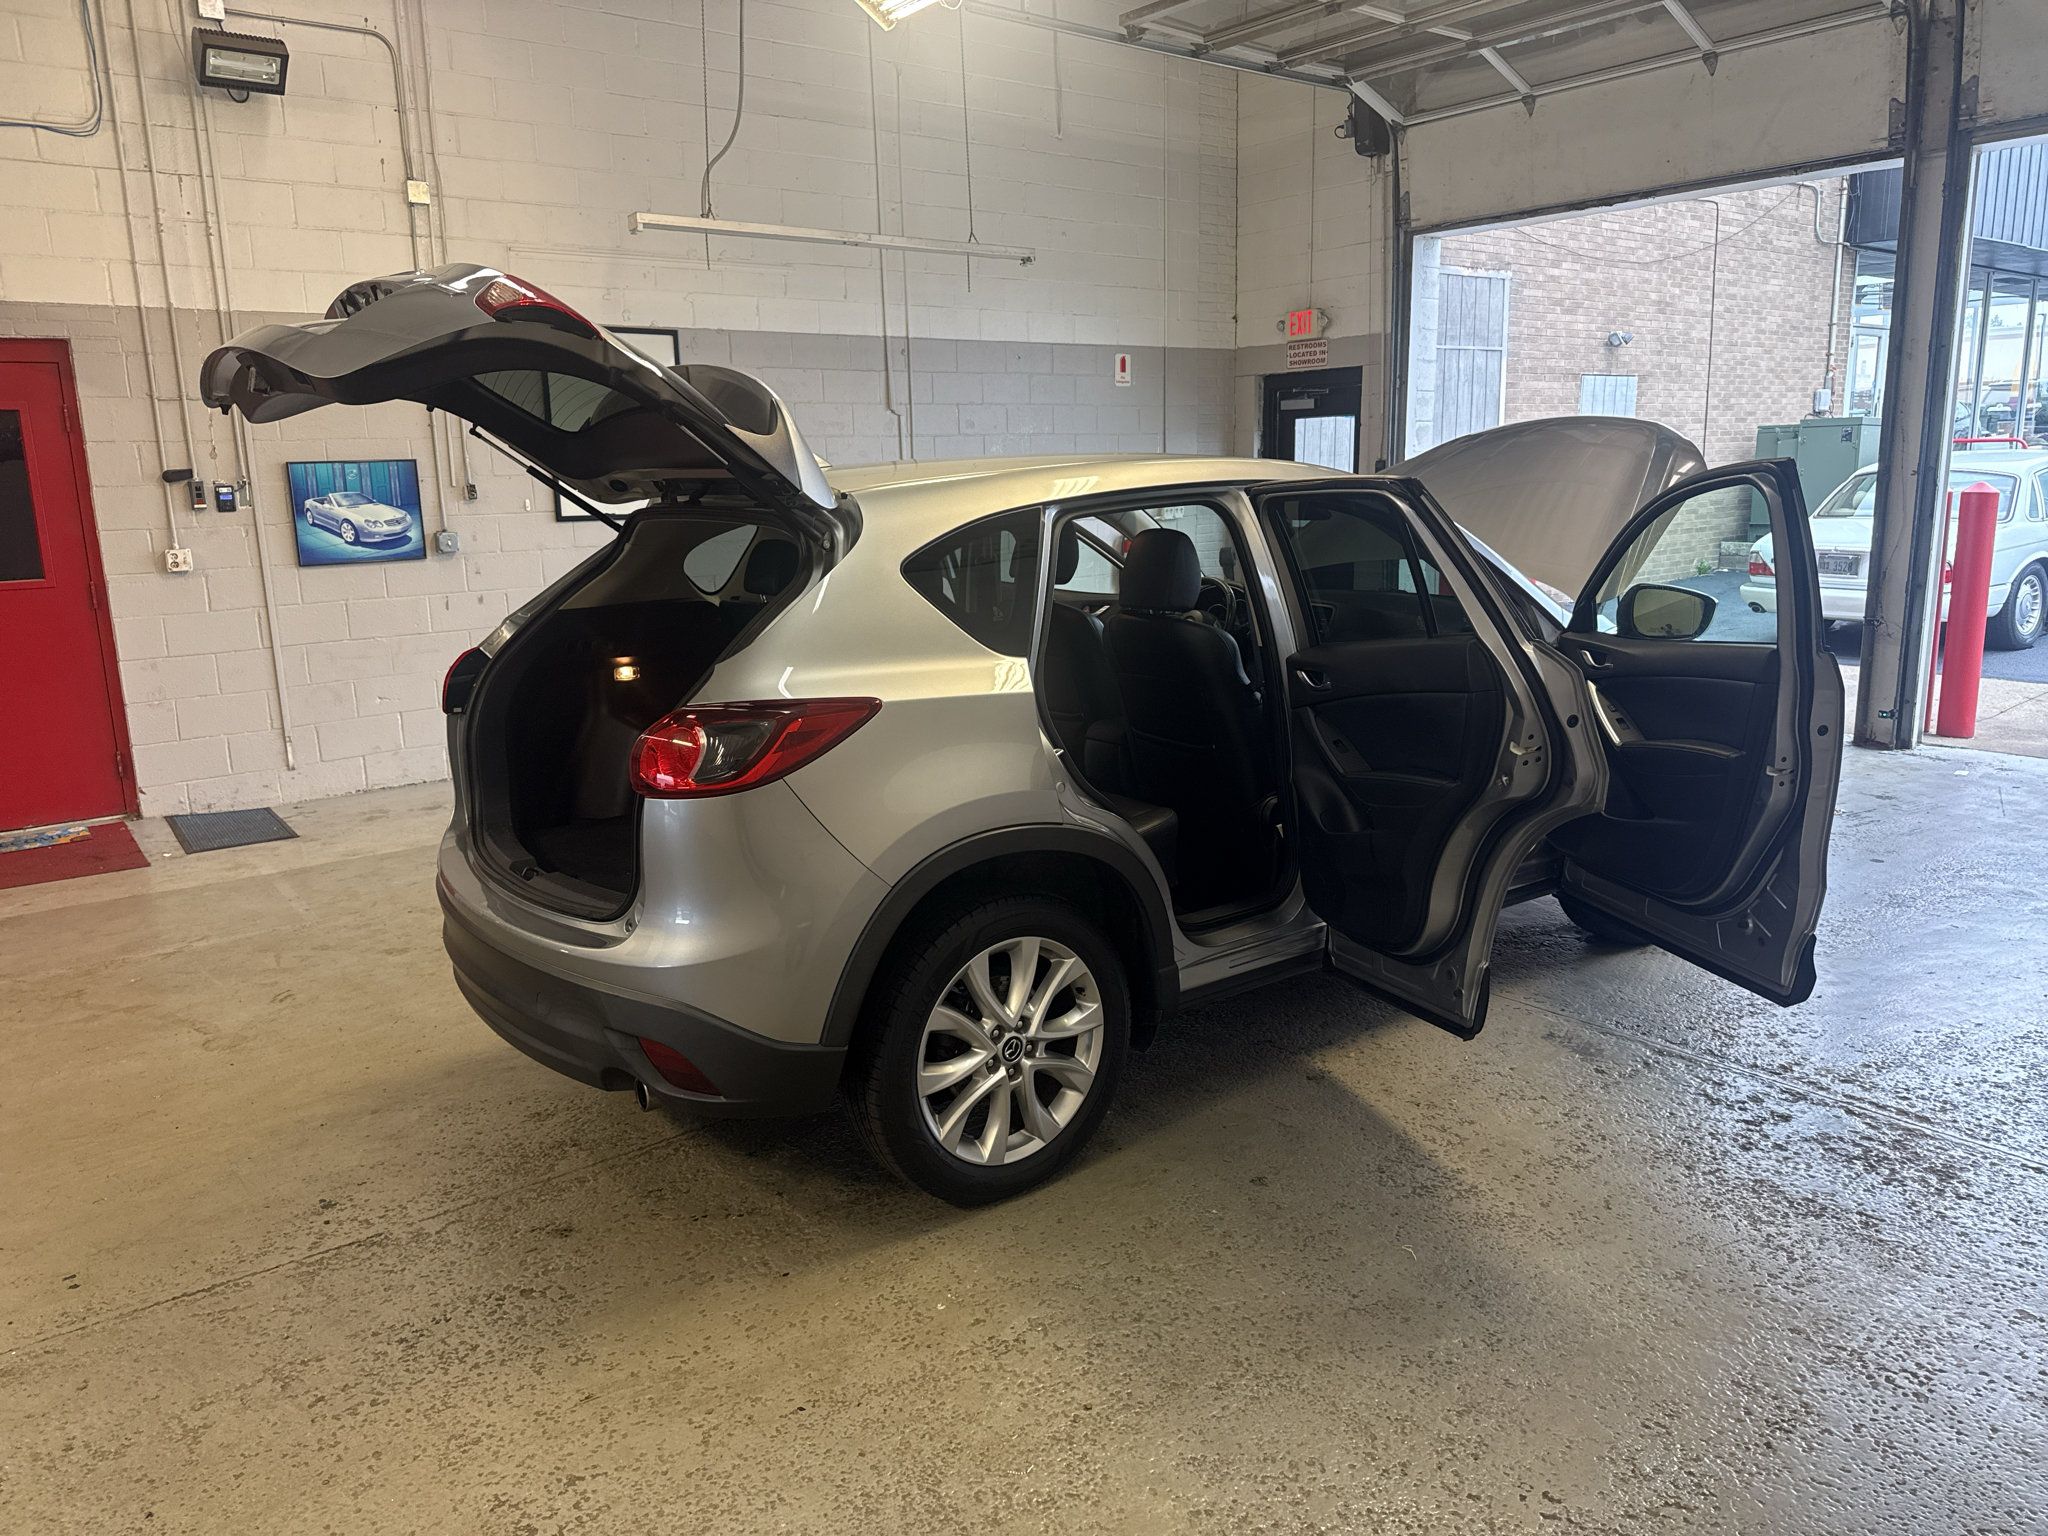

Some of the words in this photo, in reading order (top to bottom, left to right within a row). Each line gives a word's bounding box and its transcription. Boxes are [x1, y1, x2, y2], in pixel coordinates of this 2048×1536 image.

[1289, 309, 1312, 336] EXIT
[1289, 342, 1327, 350] RESTROOMS
[1289, 350, 1317, 358] LOCATED
[1289, 358, 1326, 366] SHOWROOM
